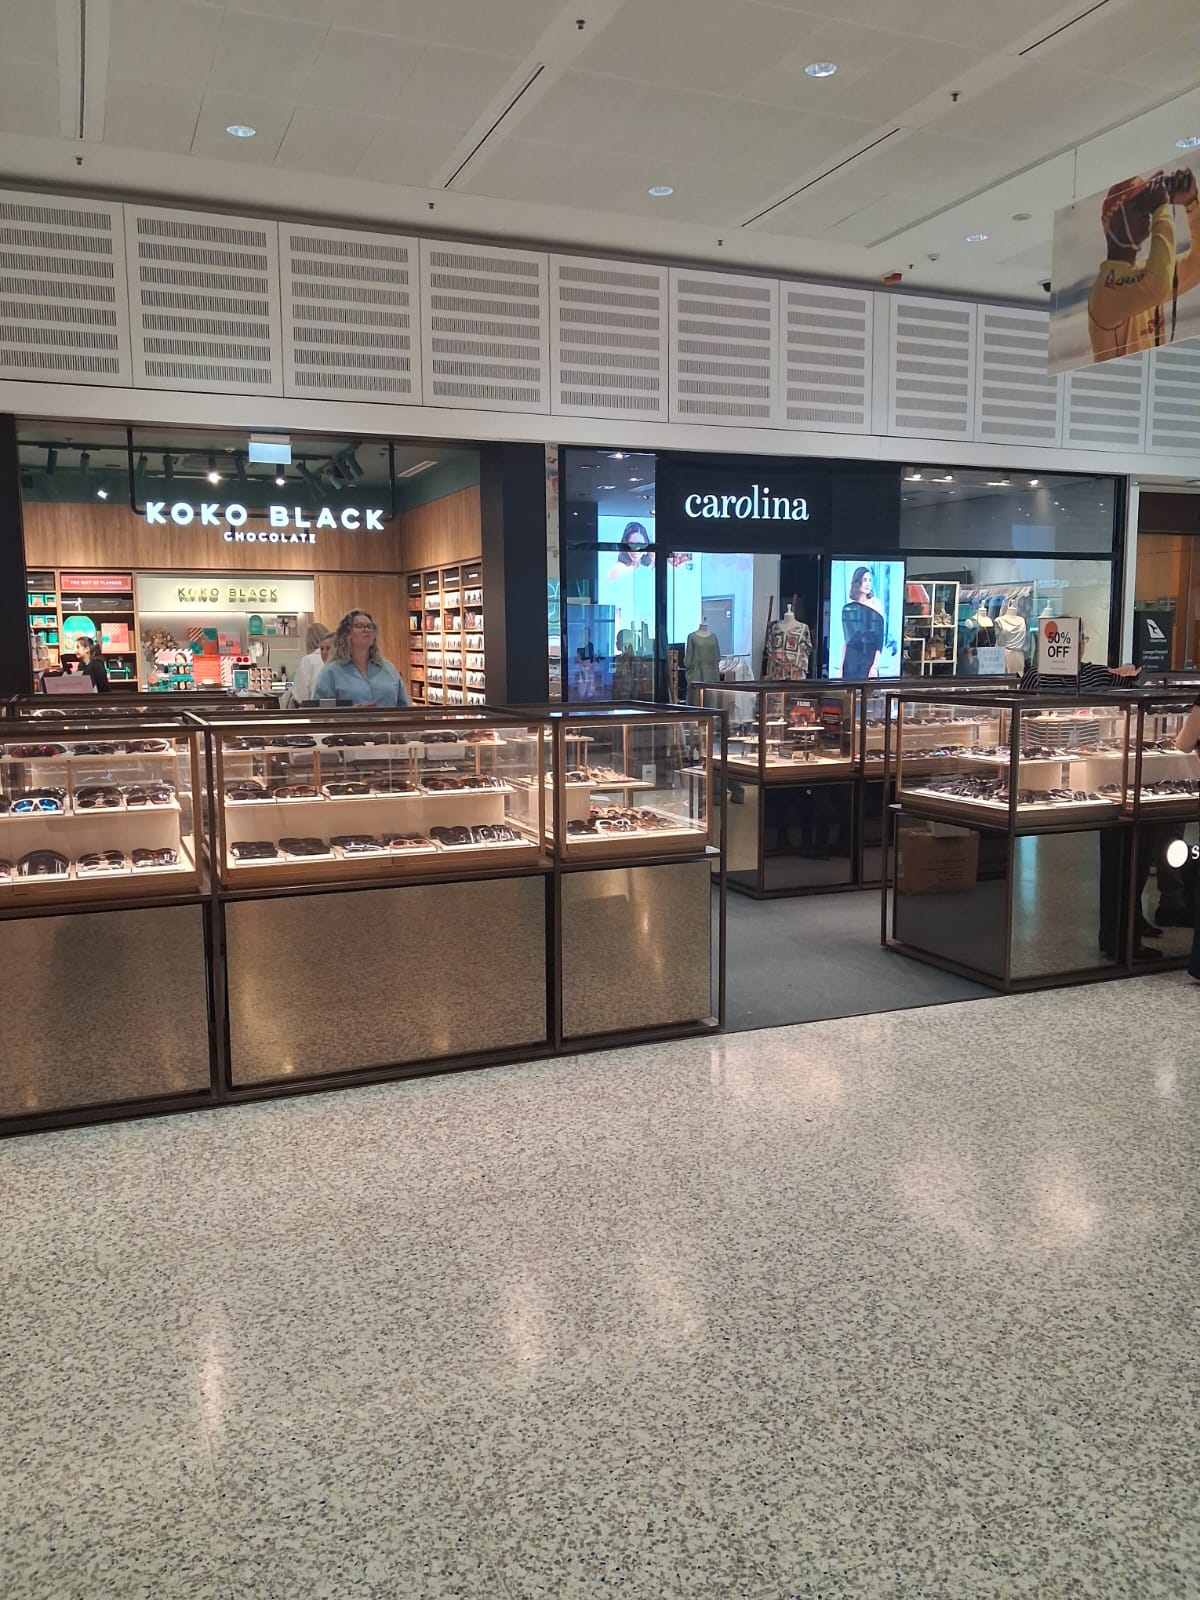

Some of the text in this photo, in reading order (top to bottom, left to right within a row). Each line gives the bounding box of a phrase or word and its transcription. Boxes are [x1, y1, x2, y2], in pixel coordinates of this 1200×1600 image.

[685, 484, 810, 521] carolina
[146, 502, 385, 530] KOKO BLACK
[223, 531, 317, 543] CHOCOLATE
[177, 587, 278, 598] KOKO BLACK
[1047, 631, 1072, 644] 50%
